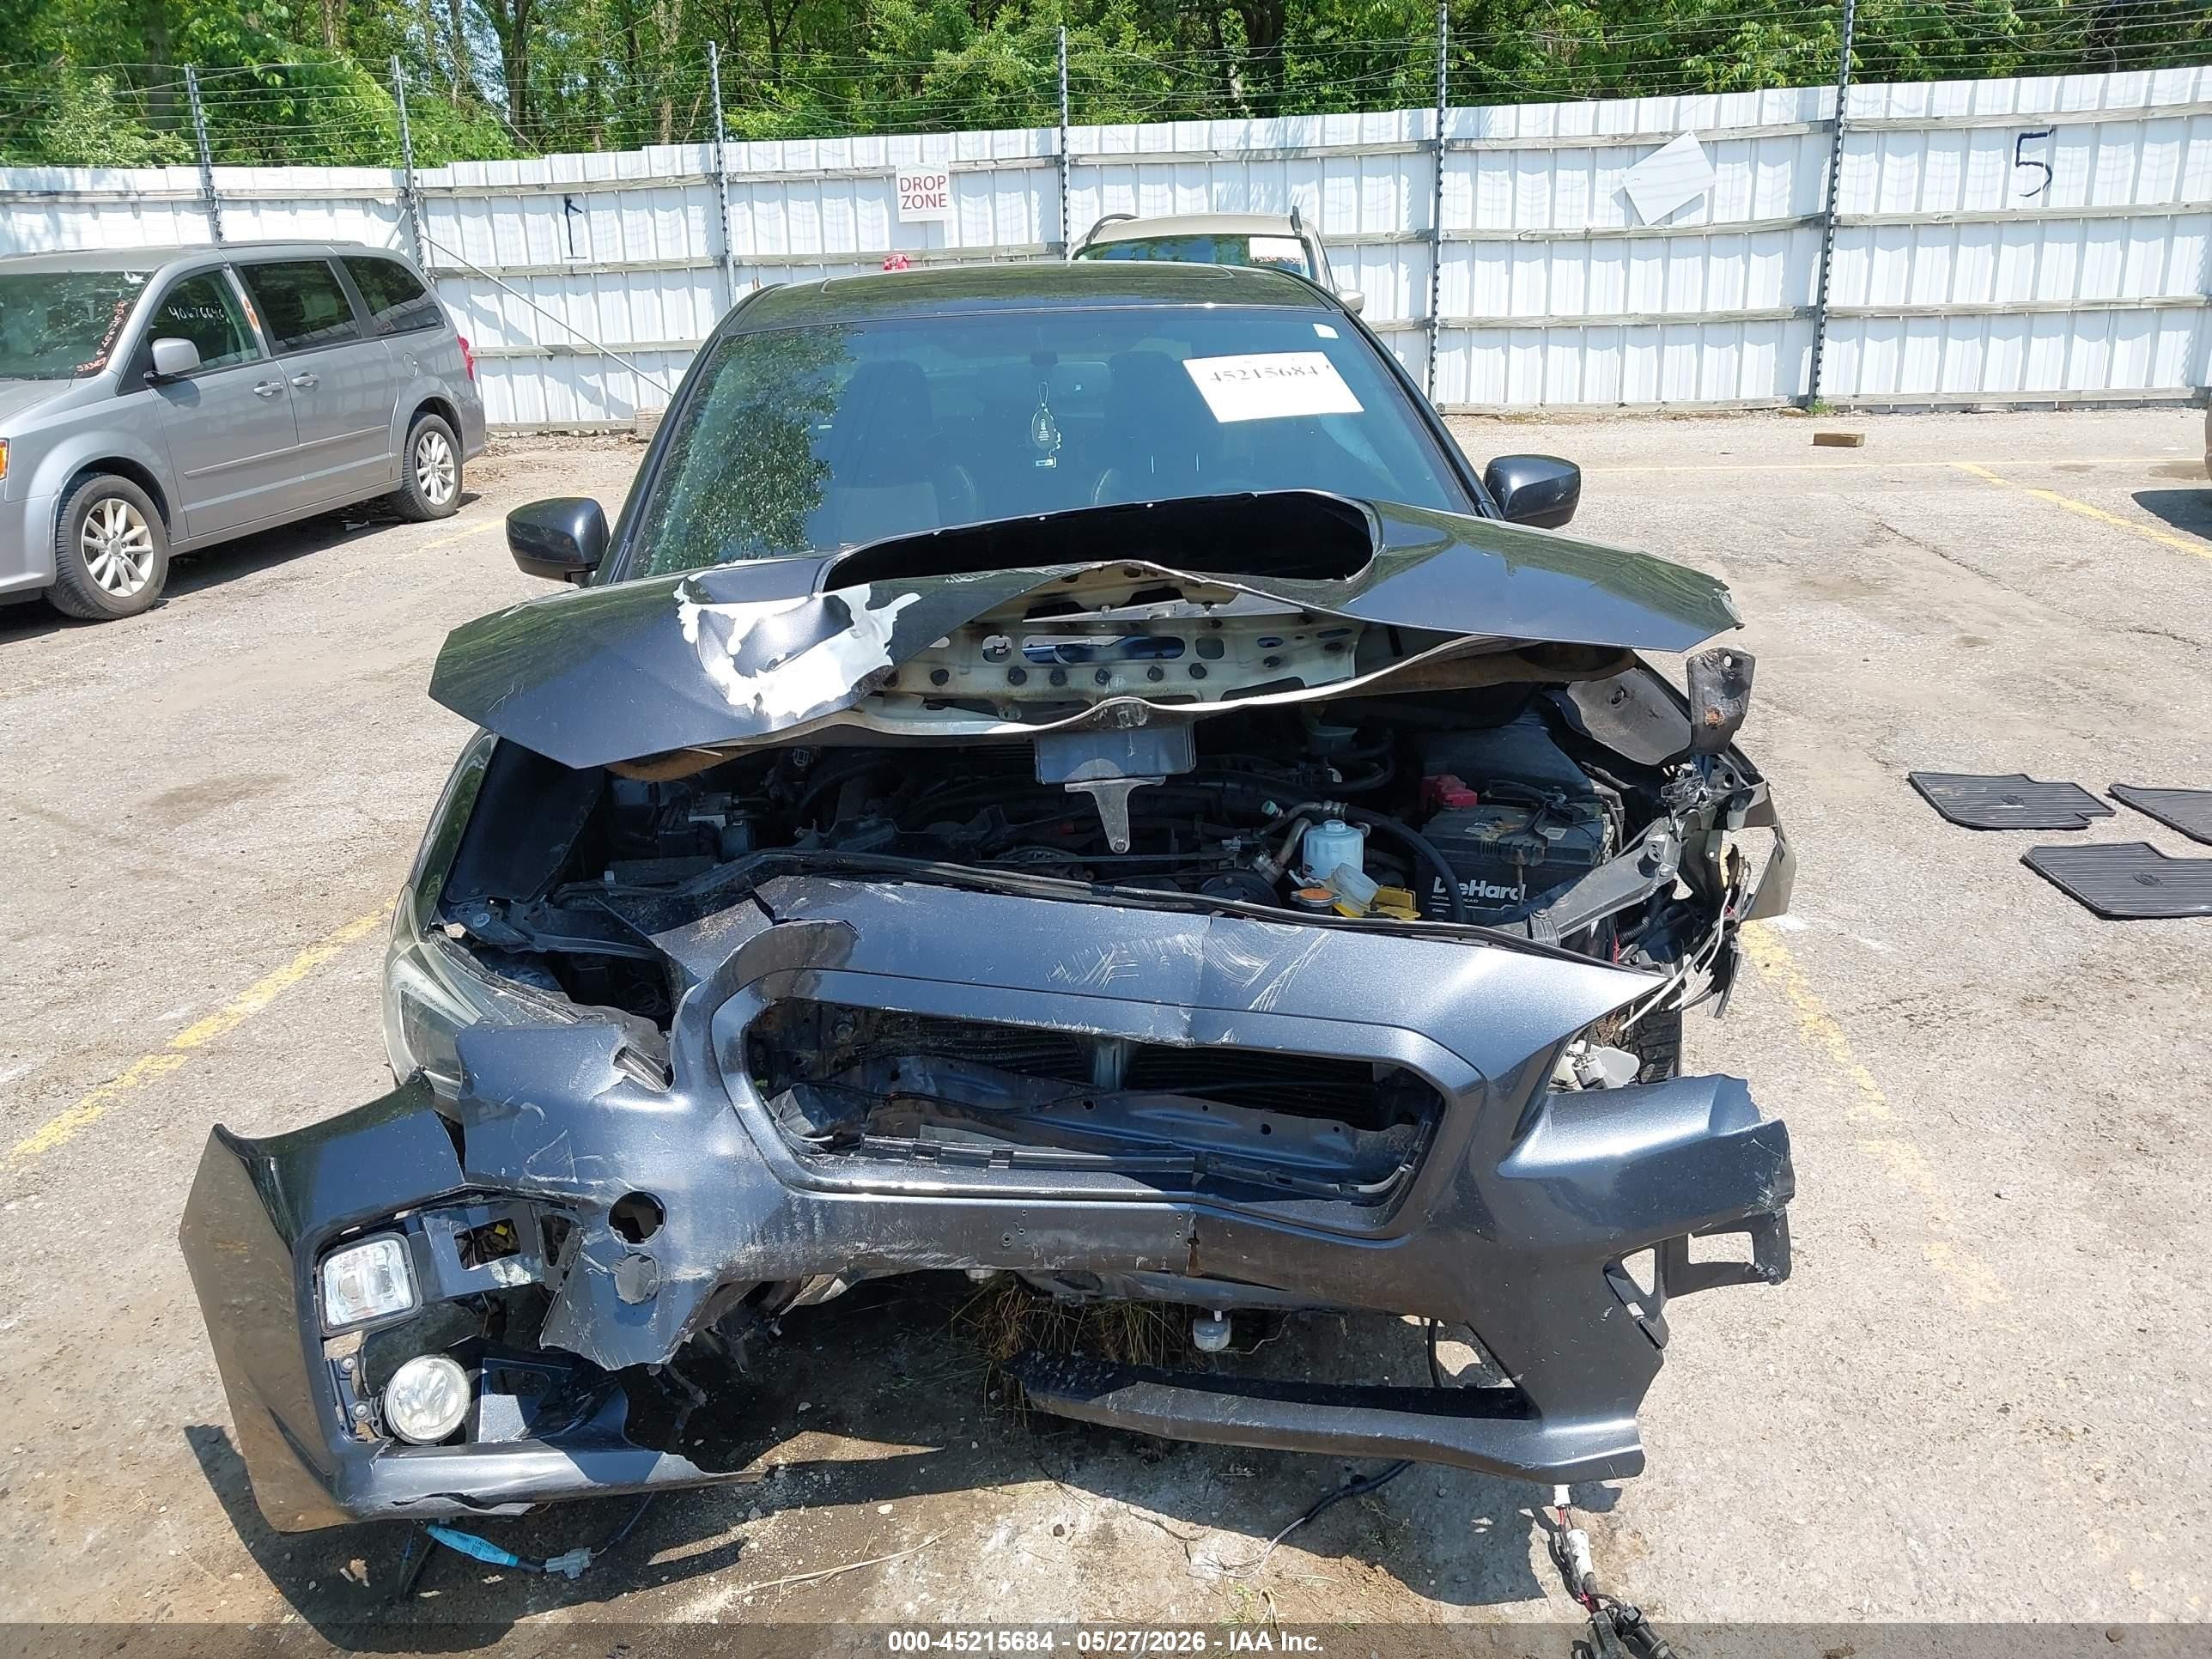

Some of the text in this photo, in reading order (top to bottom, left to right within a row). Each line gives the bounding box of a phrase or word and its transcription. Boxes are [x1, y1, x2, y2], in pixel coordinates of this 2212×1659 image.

[2015, 129, 2053, 198] 5
[899, 174, 946, 192] DROP
[901, 192, 948, 210] ZONE
[1432, 876, 1527, 902] DeHard
